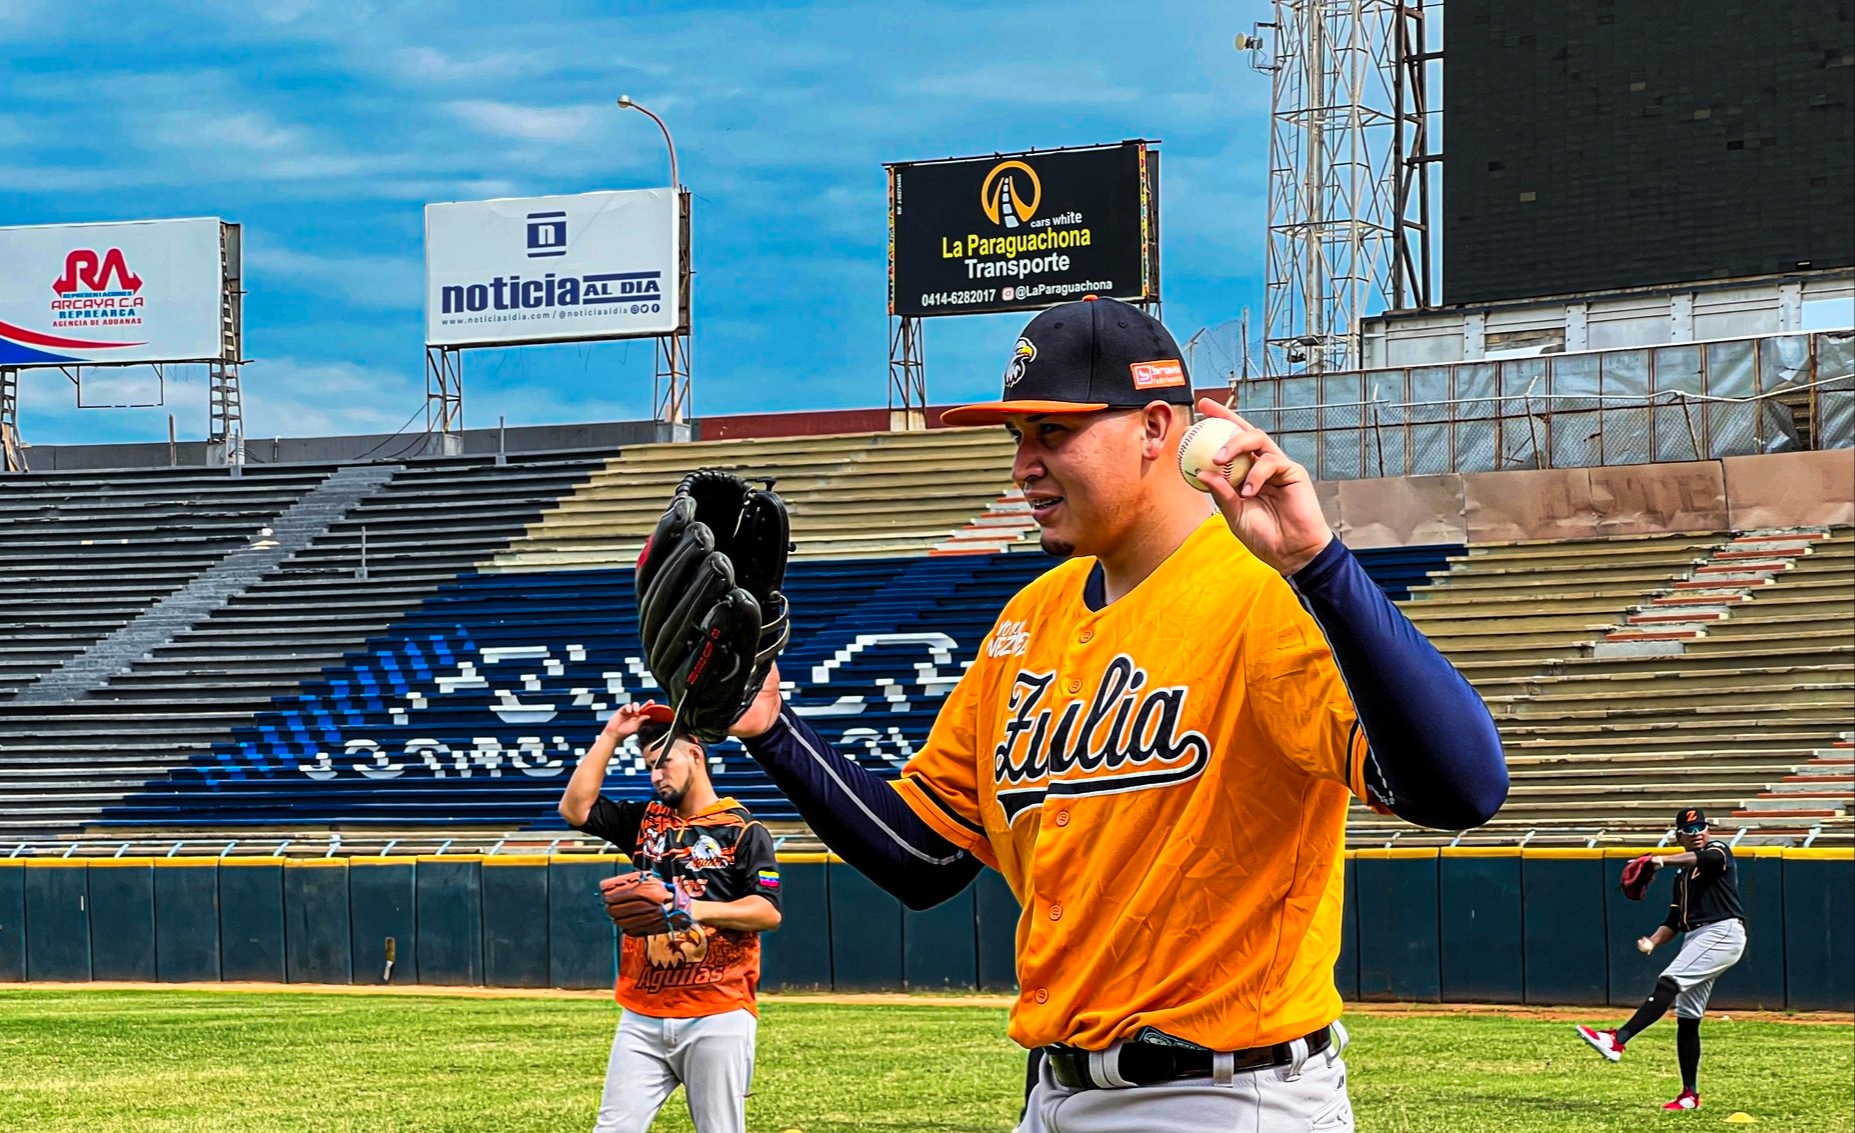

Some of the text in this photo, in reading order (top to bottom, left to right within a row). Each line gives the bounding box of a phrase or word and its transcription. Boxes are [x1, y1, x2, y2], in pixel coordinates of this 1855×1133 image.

[1030, 211, 1082, 229] cars white
[942, 227, 1091, 258] La Paraguachona
[964, 251, 1070, 279] Transporte
[442, 273, 660, 314] noticia AL DIA
[921, 279, 1113, 306] 0414-6282017 @LaParaguachona
[51, 298, 115, 310] ARCAYA
[59, 309, 135, 318] REPREARCA
[102, 318, 142, 326] ADUANAS
[442, 313, 550, 325] www.noticiaaldia.com
[559, 307, 628, 319] @noticiaaldia
[995, 654, 1211, 785] Zulia
[1686, 810, 1698, 822] Z
[634, 962, 725, 994] Aguilas
